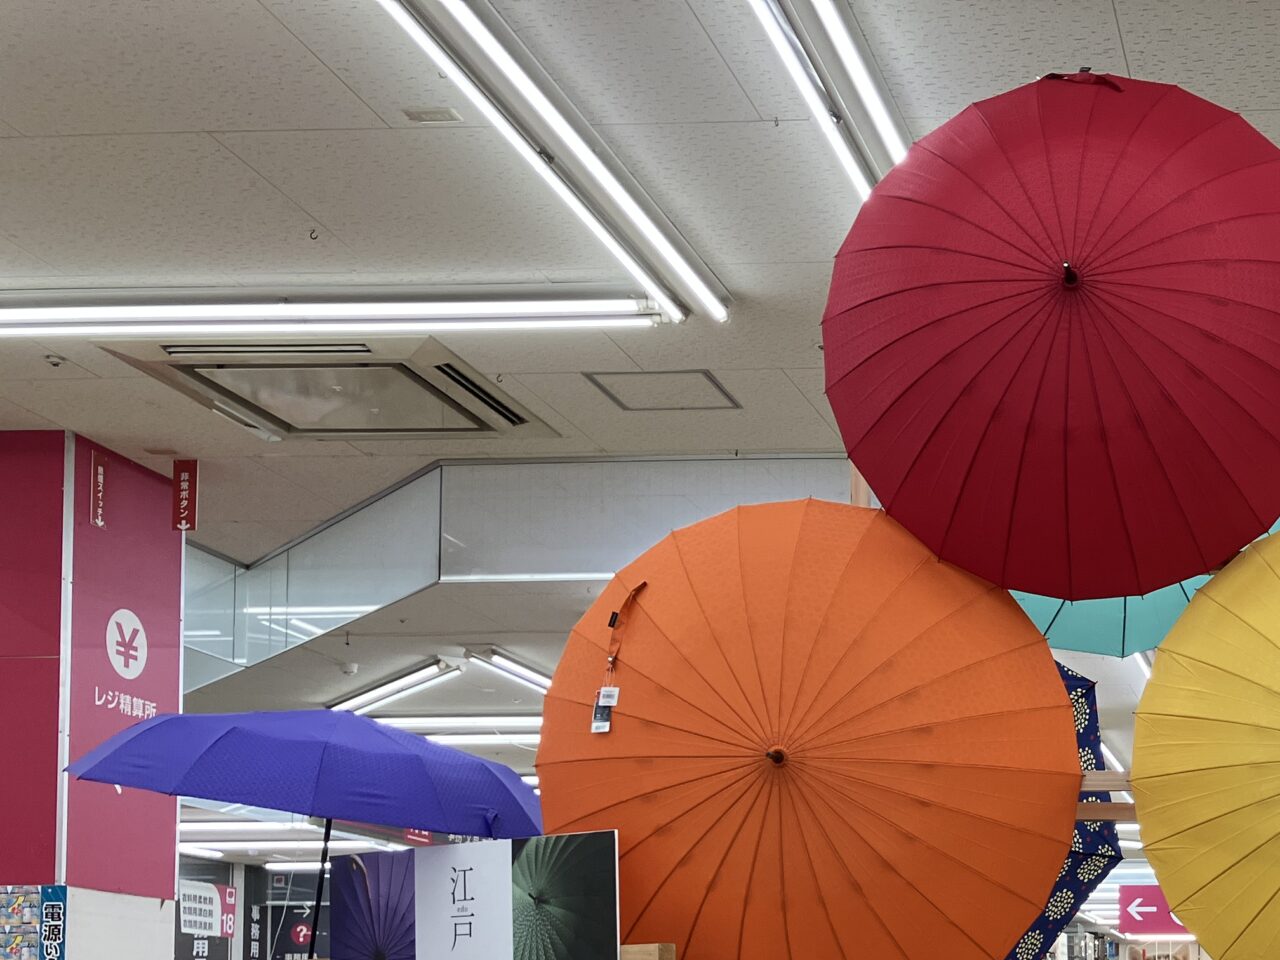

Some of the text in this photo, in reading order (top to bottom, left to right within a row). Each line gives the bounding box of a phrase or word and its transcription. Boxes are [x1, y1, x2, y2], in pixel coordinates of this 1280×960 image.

[95, 686, 157, 719] レジ精算所
[222, 913, 235, 934] 18
